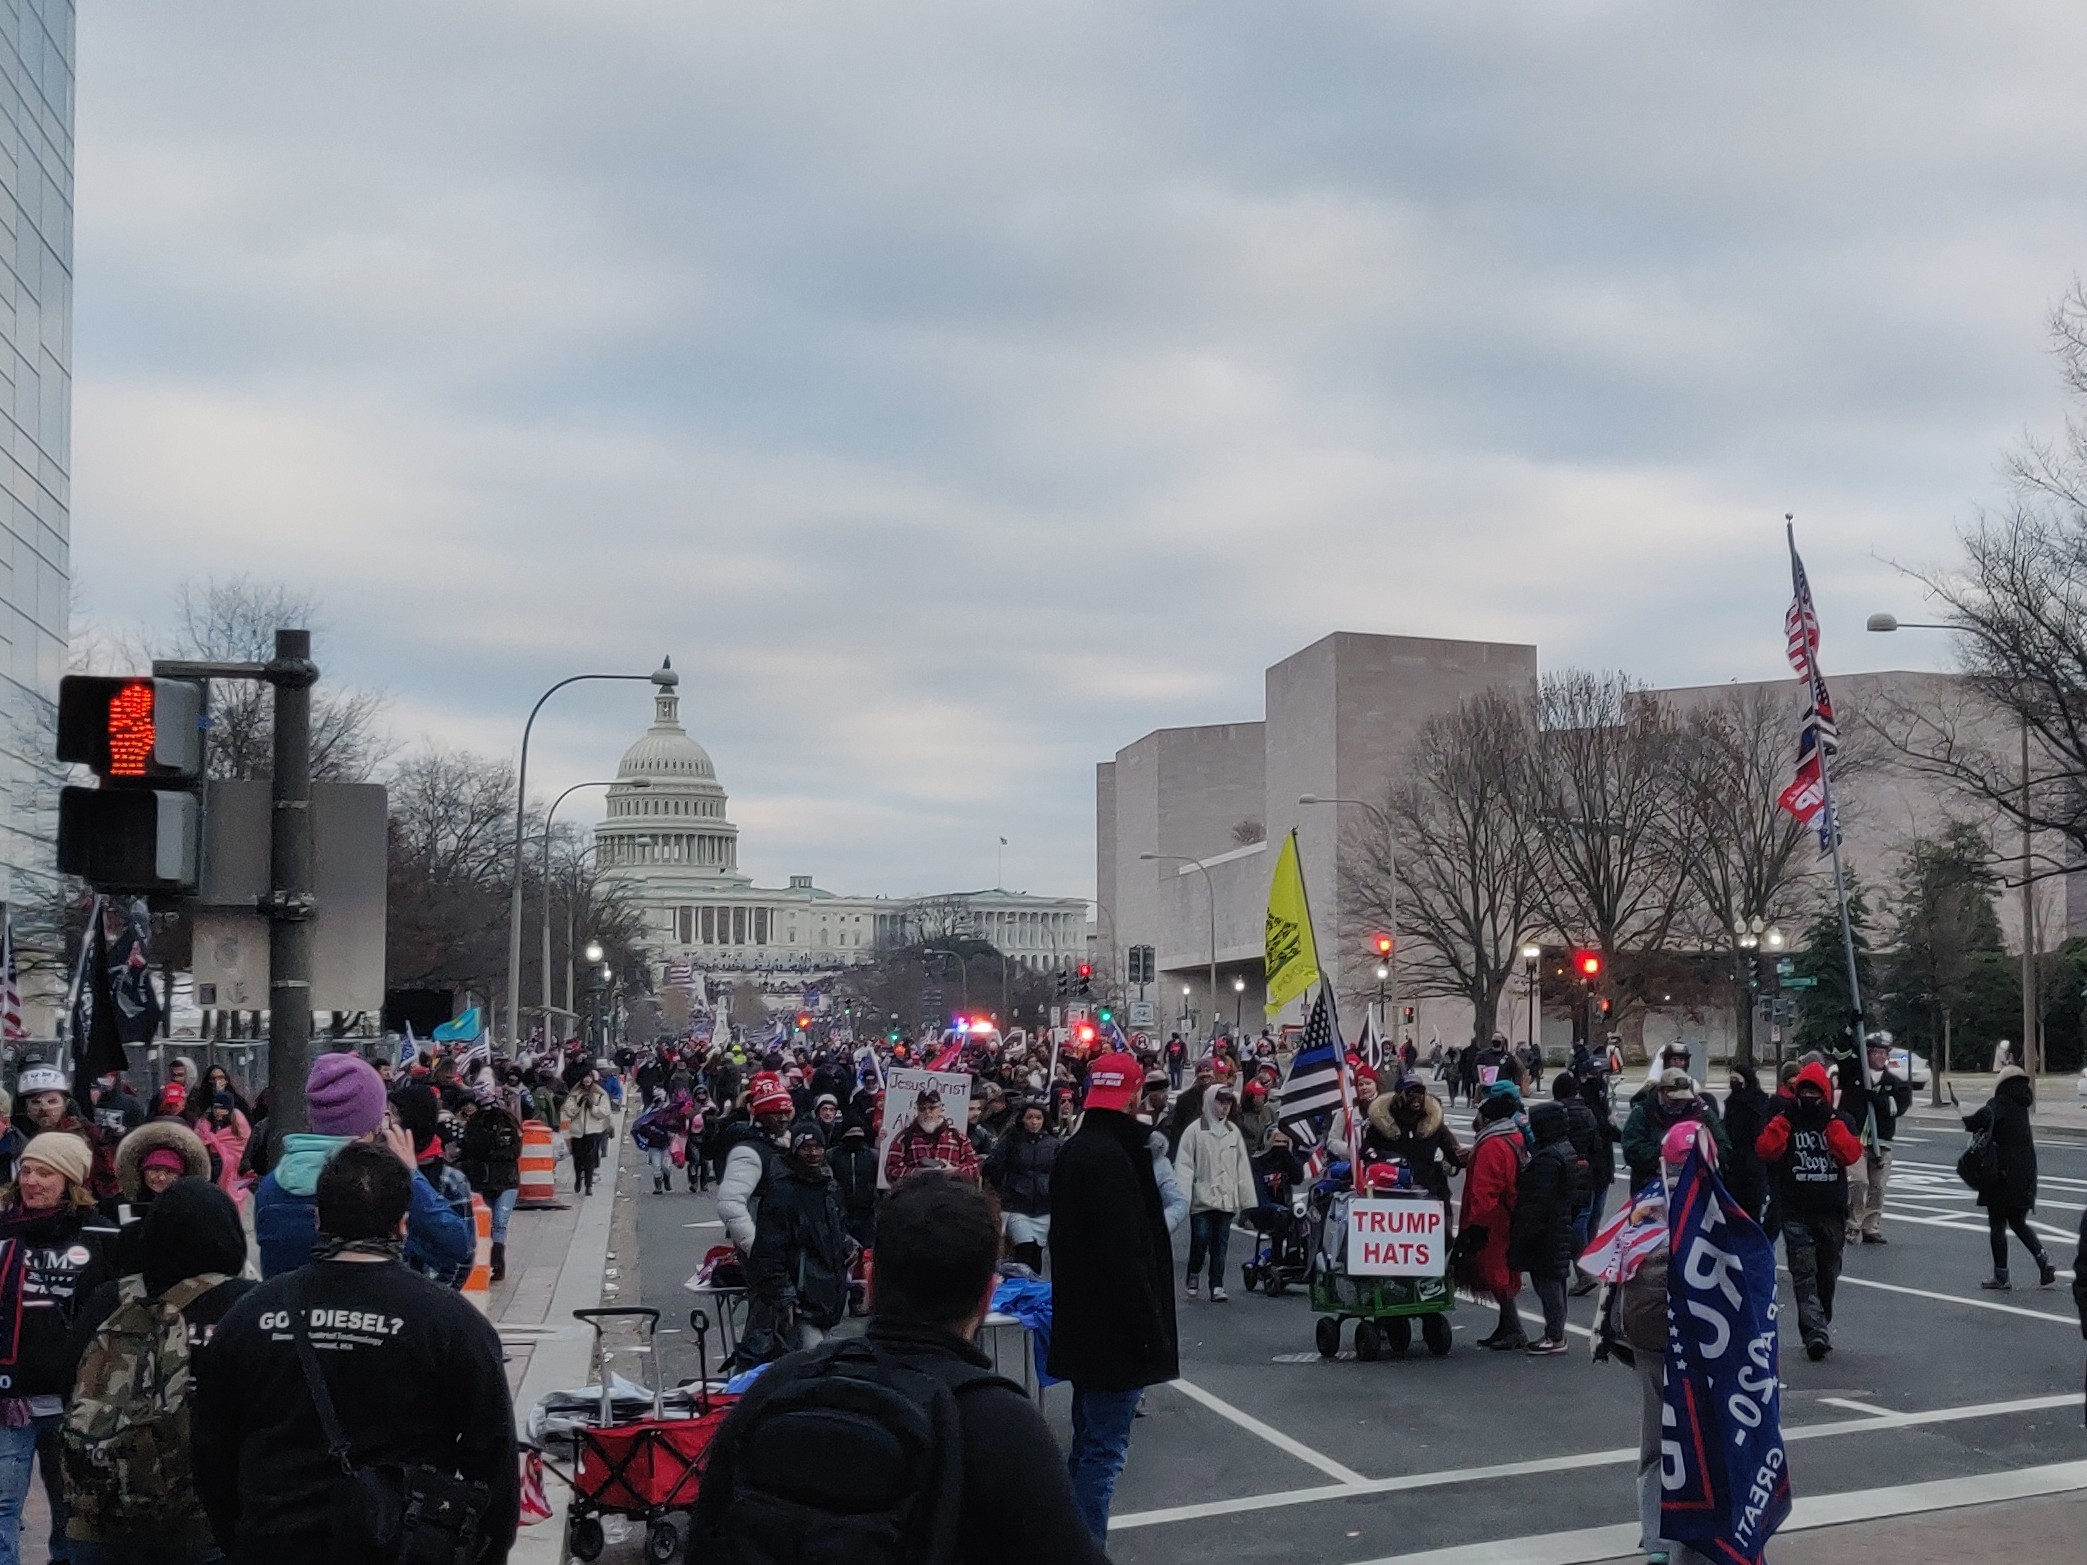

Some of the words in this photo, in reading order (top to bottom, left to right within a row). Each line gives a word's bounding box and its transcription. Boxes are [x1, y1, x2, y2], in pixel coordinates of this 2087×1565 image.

[889, 1072, 926, 1092] Jesus
[1353, 1211, 1440, 1233] TRUMP
[1364, 1242, 1430, 1264] HATS
[259, 1309, 305, 1330] GO
[310, 1309, 404, 1335] DIESEL?
